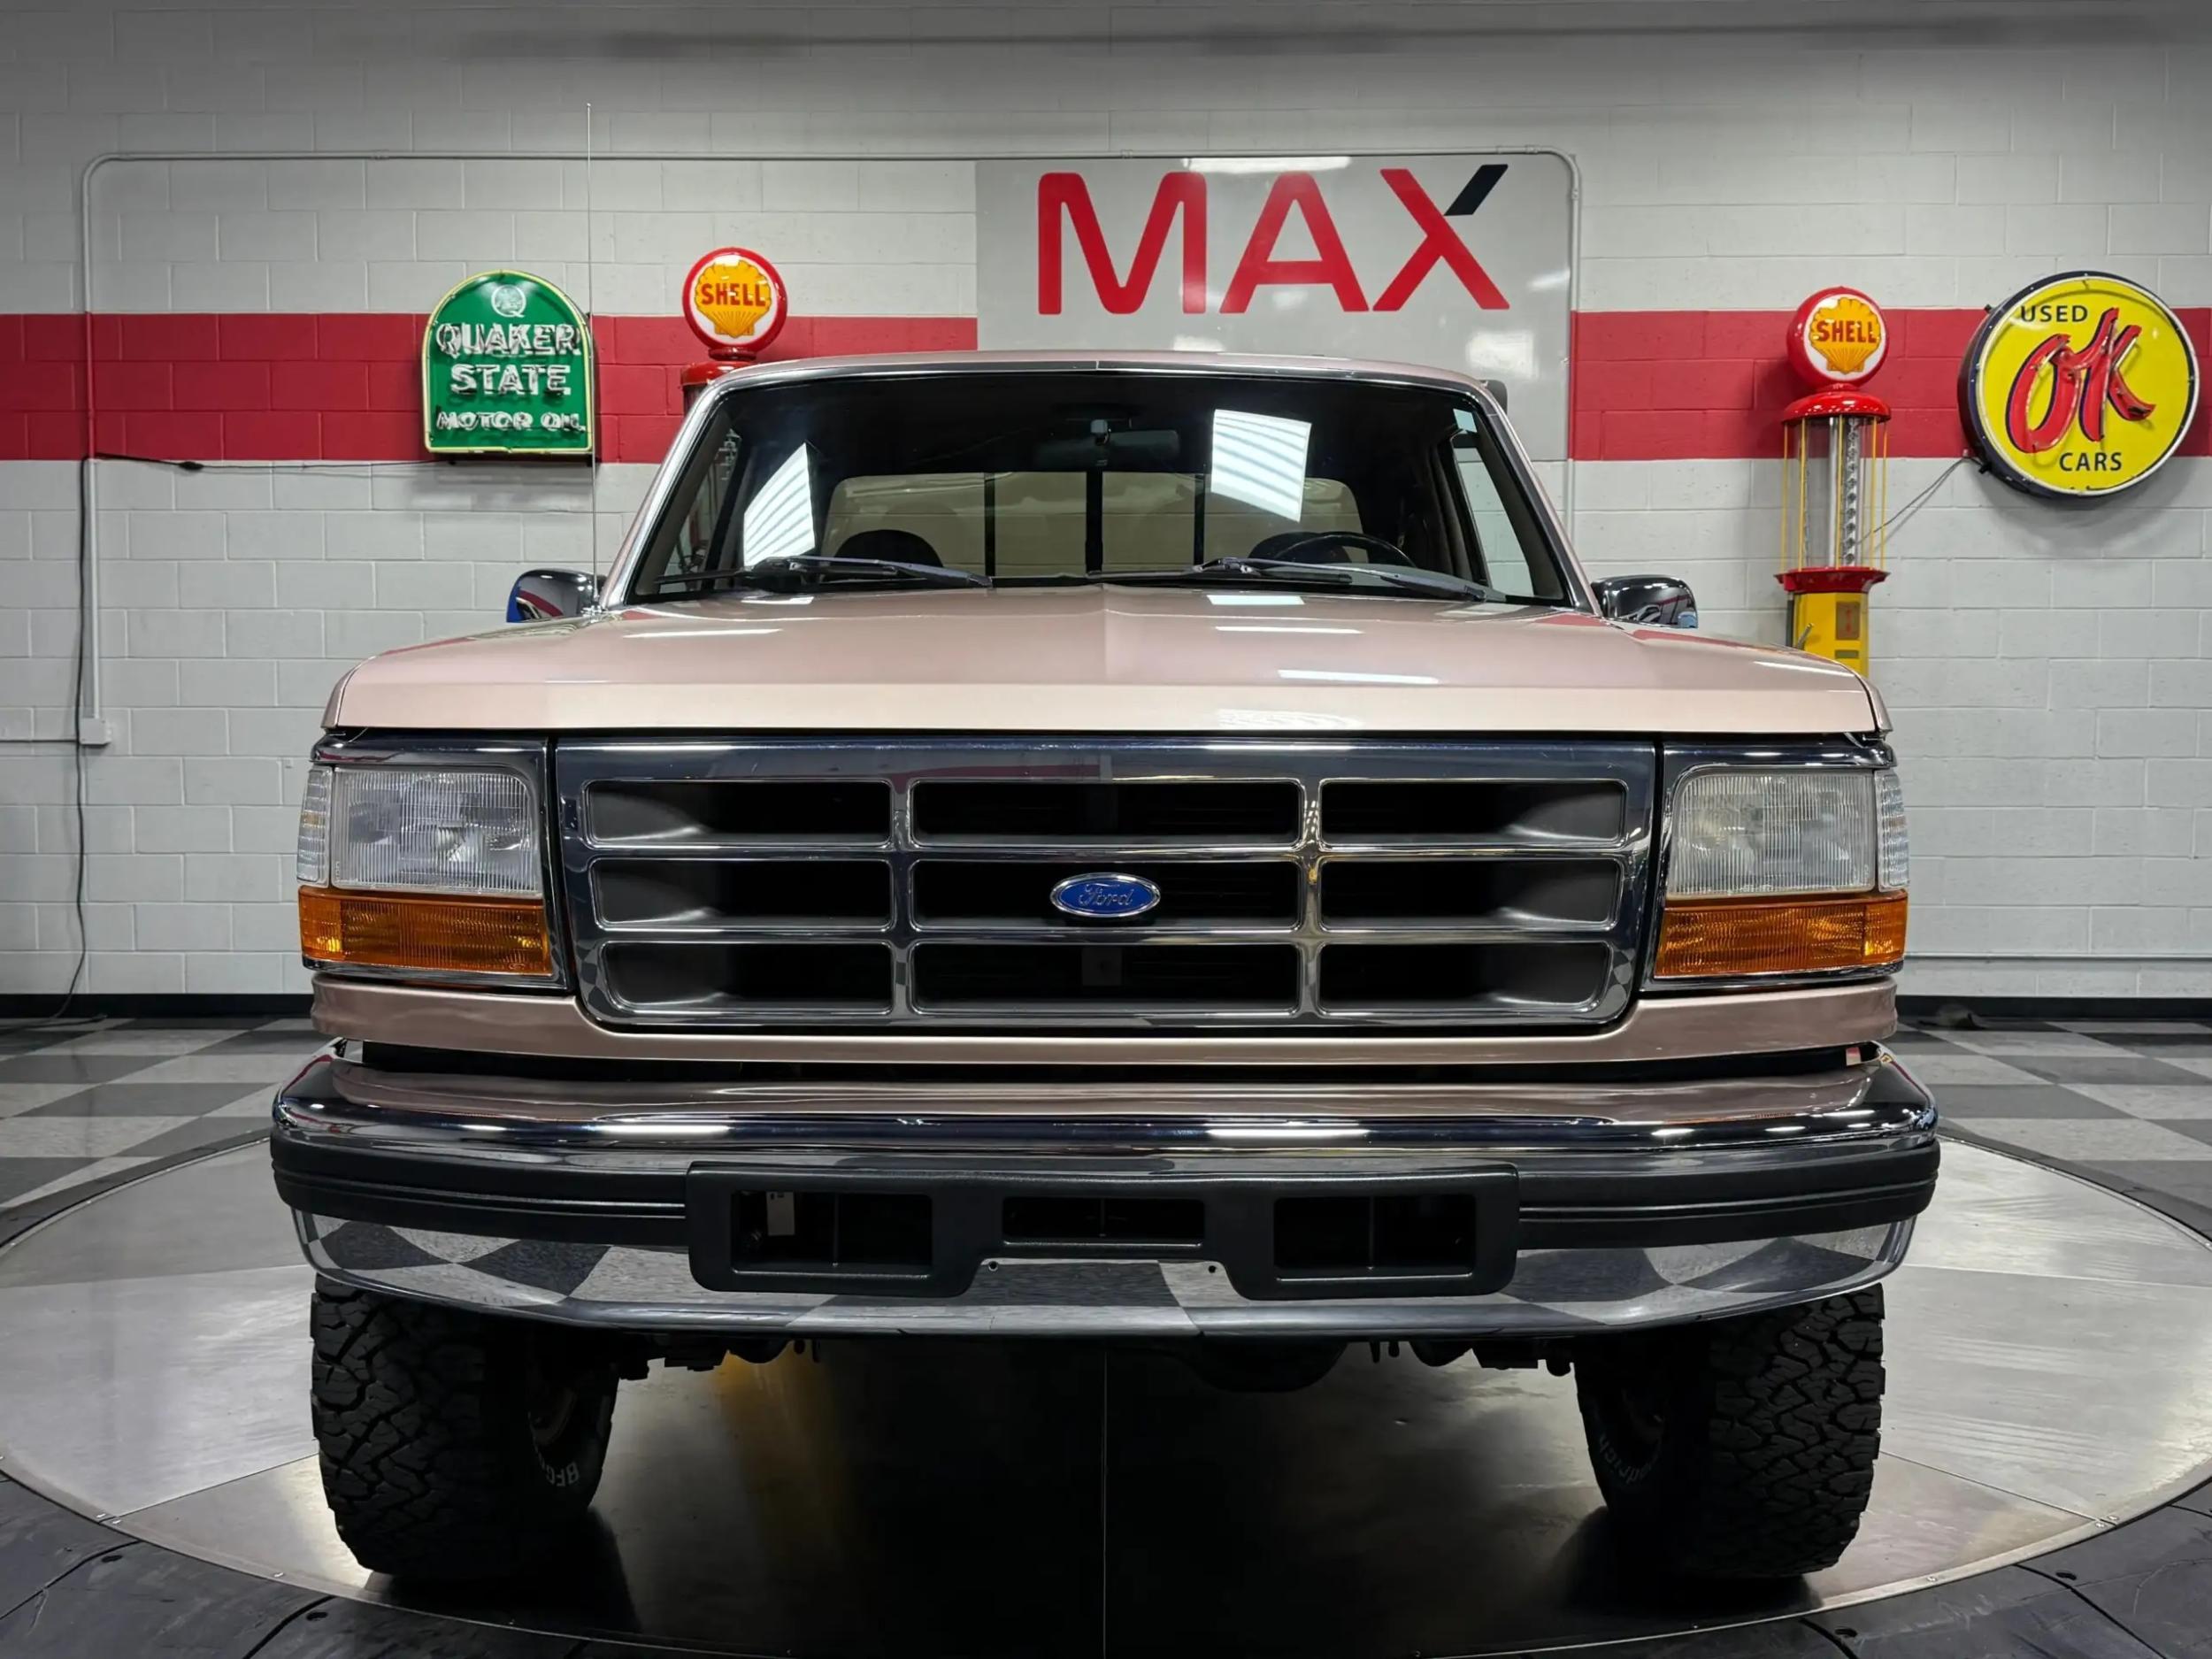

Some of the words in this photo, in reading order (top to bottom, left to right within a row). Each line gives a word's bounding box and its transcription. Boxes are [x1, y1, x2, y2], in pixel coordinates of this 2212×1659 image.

[1038, 164, 1510, 315] MAX
[701, 282, 766, 307] SHELL
[2020, 304, 2088, 323] USED
[436, 322, 581, 359] QUAKER
[1816, 319, 1877, 343] SHELL
[450, 363, 572, 396] STATE
[2005, 306, 2156, 454] OK
[436, 411, 534, 432] MOTOR
[541, 411, 587, 433] OIL
[2059, 452, 2122, 472] CARS
[1078, 883, 1136, 907] Ford
